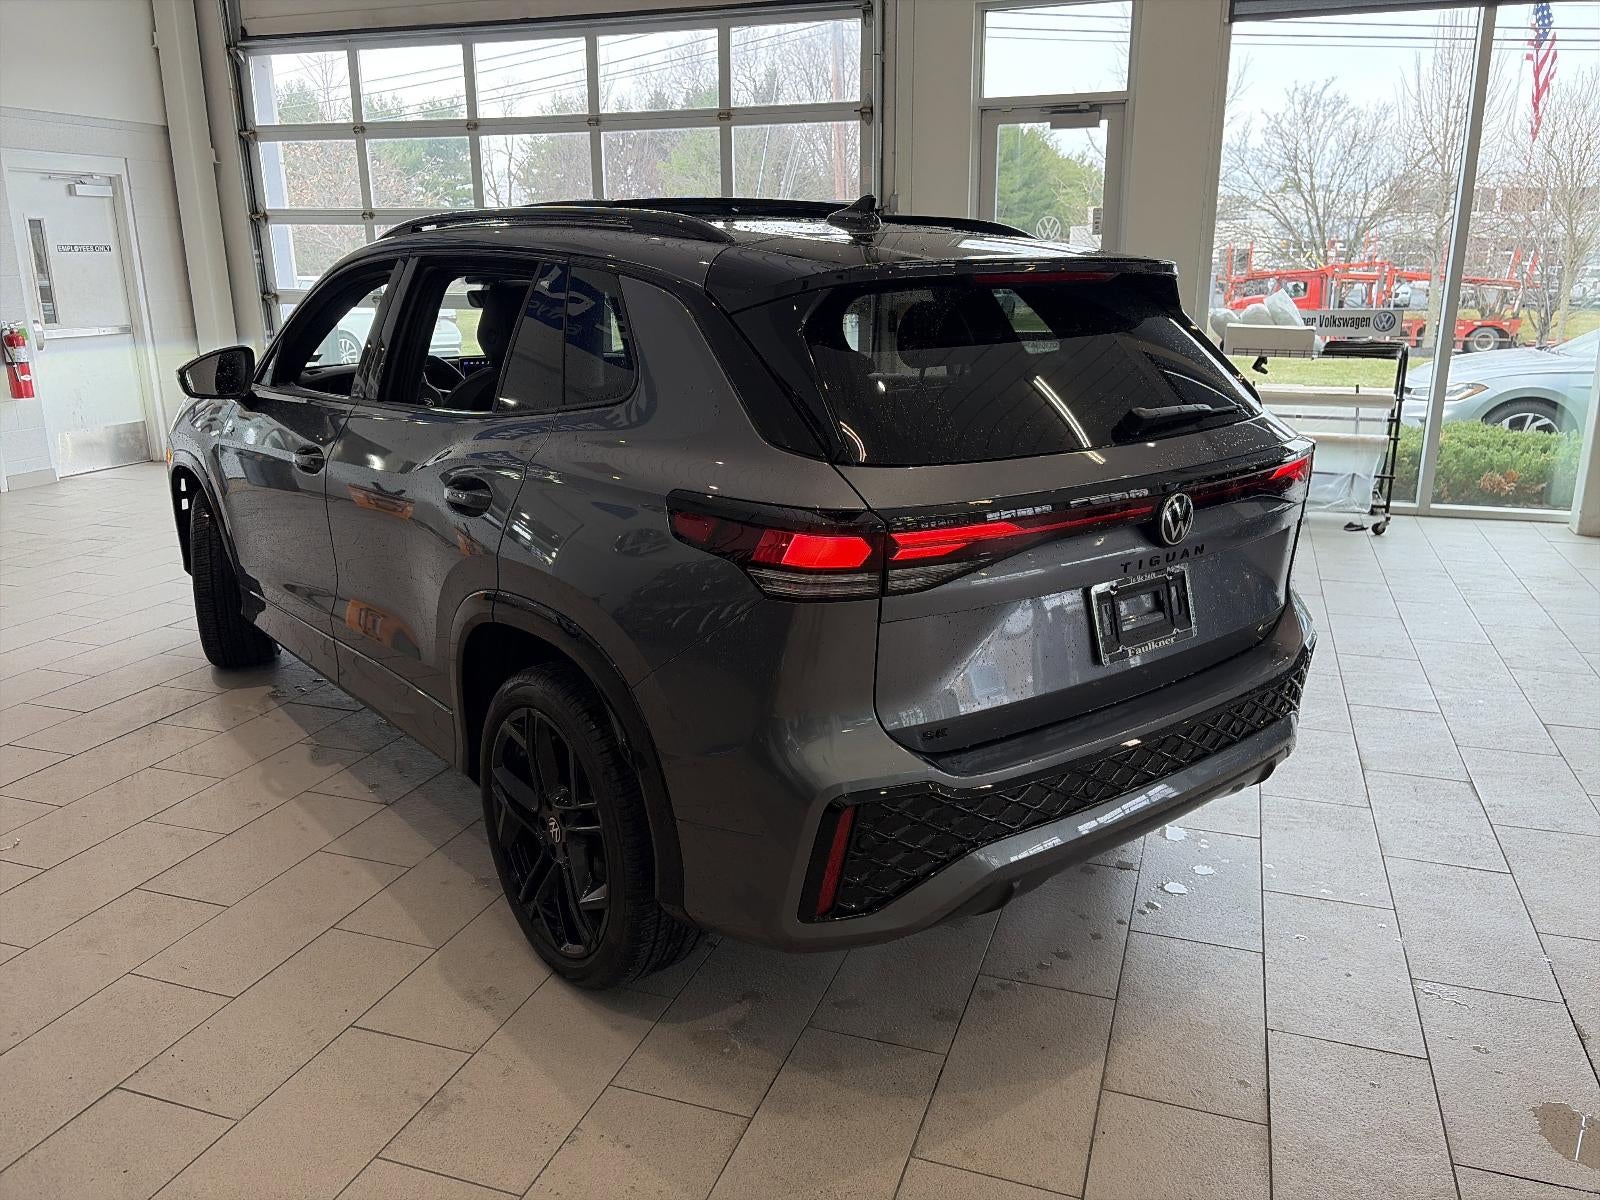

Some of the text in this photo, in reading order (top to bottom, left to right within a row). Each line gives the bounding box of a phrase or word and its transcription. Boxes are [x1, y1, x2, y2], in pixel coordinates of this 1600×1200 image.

[1319, 314, 1371, 330] Volkswagen
[1120, 543, 1205, 573] TIGUAN
[1127, 636, 1177, 657] Faulkner
